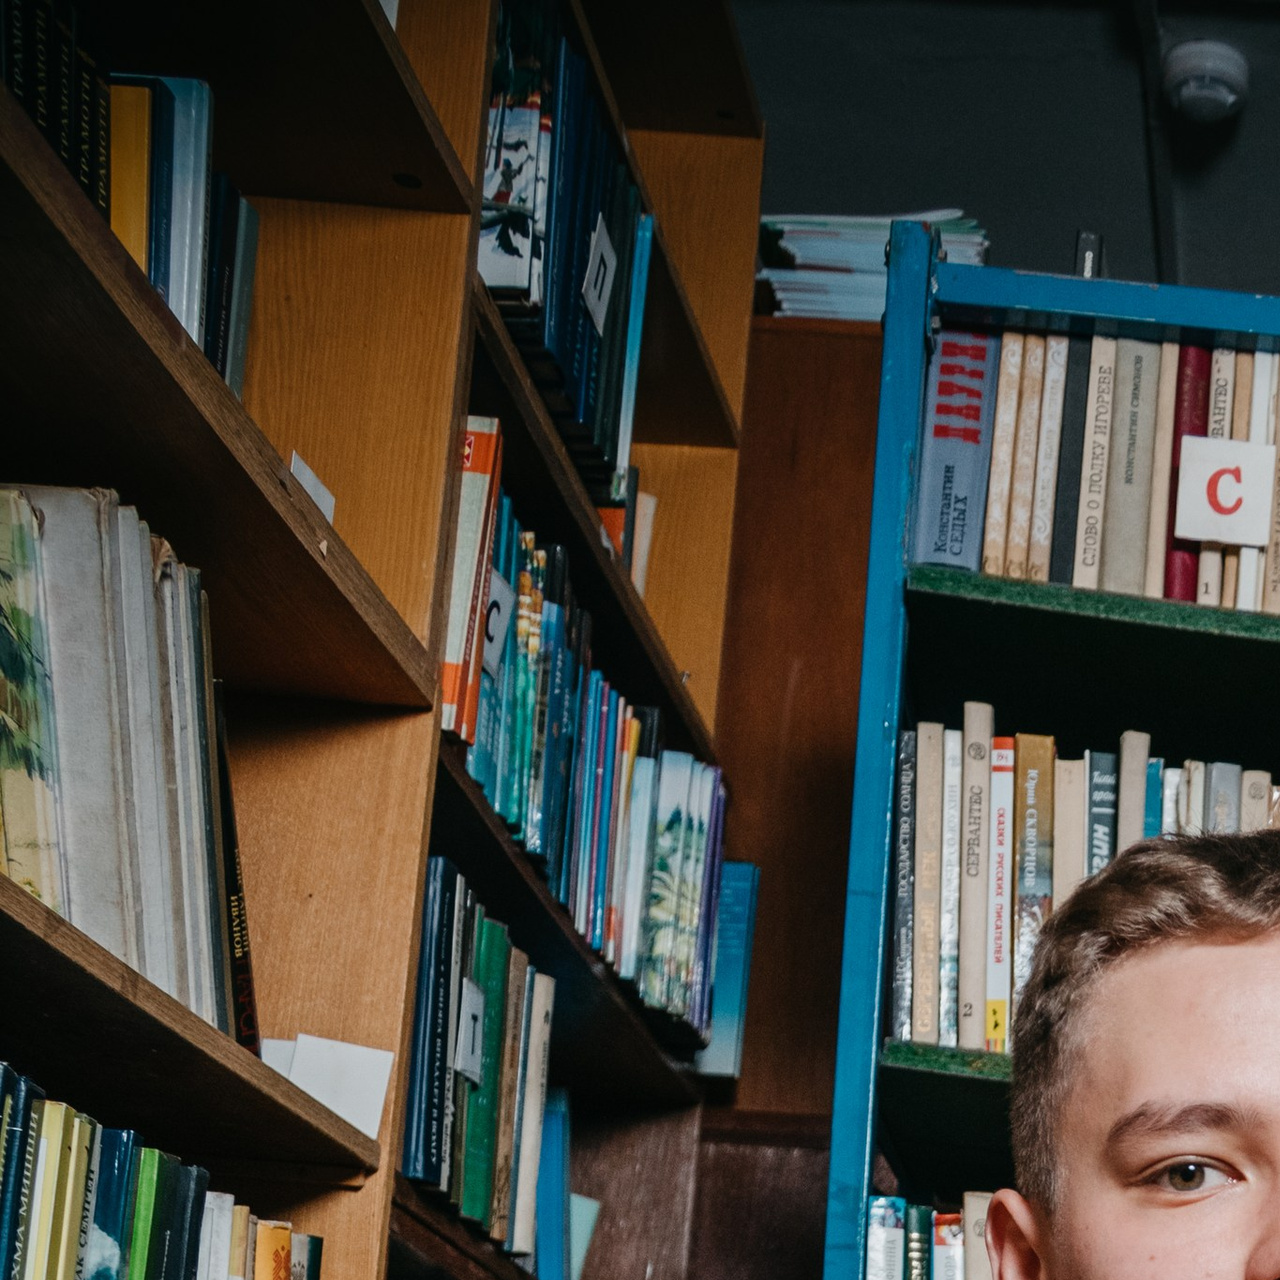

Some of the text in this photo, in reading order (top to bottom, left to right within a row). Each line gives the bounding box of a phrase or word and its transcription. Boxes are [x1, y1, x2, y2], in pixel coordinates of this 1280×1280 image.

[1124, 355, 1144, 485] КОНСТАНТИН СИМОНОВ
[1211, 378, 1229, 438] ВАНТЕС
[1081, 365, 1113, 567] СЛОВО О ПОЛКУ ИГОРЕВЕ
[1206, 466, 1243, 516] С
[934, 465, 956, 553] Константин
[950, 495, 969, 556] СЕДЫХ
[484, 600, 501, 643] С
[898, 762, 914, 897] ГОСУДАРСТВО СОЛНЦА
[966, 785, 984, 878] СЕРВАНТЕС
[993, 807, 1005, 964] СКАЗКИ РУССКИХ ПИСАТЕЛЕЙ
[230, 895, 244, 959] ИВАНОВ
[962, 1002, 972, 1017] 2
[18, 1111, 38, 1217] МИШШИ
[886, 1238, 899, 1280] ФИННА
